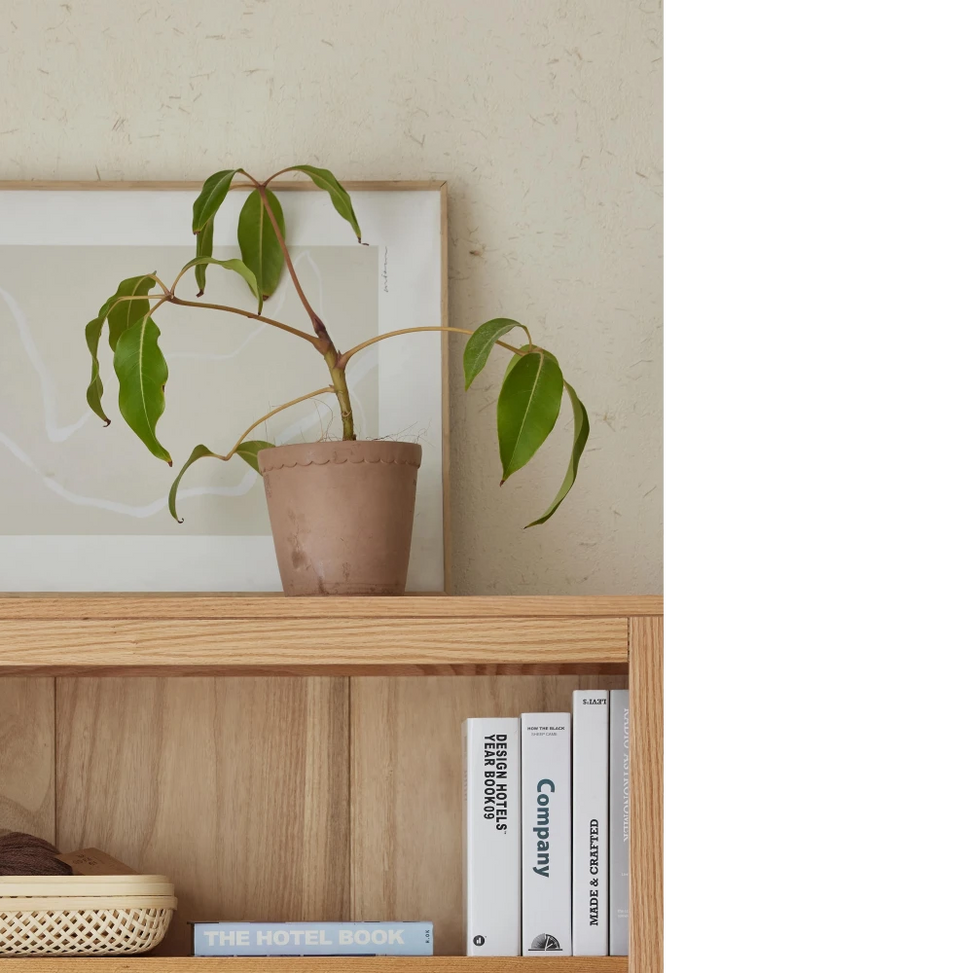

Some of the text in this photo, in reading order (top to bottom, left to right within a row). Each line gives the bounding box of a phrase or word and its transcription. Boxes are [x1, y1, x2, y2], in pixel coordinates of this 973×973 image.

[484, 734, 495, 766] YEAR
[496, 734, 507, 779] DESIGN
[532, 778, 555, 878] Company
[589, 818, 599, 926] MADE & CRAFTED
[203, 929, 405, 946] THE HOTEL BOOK
